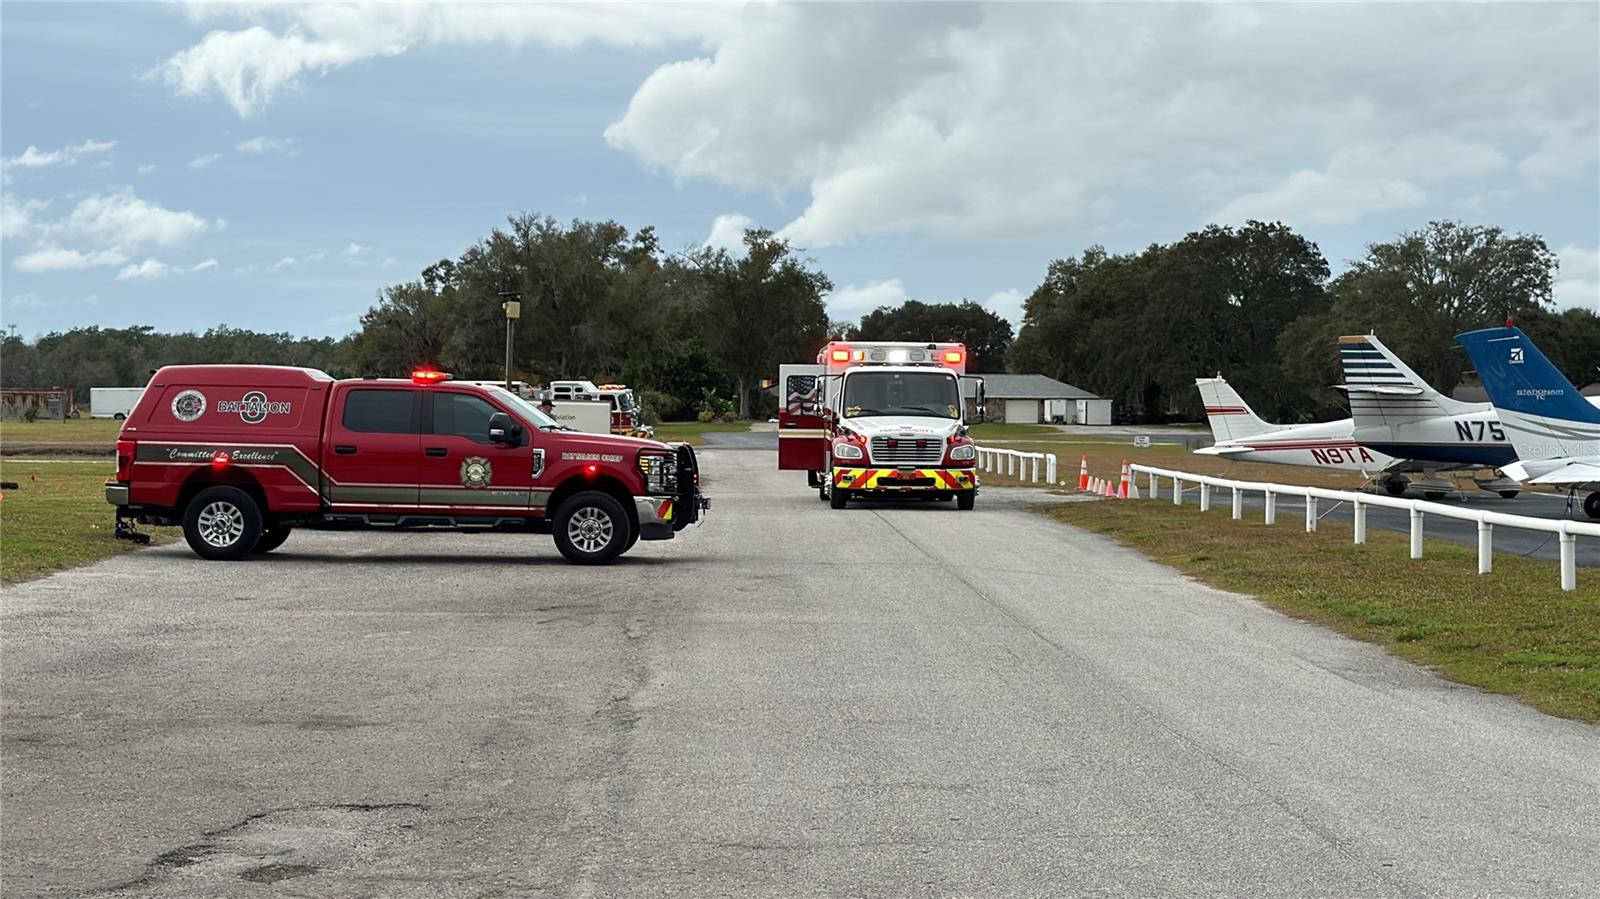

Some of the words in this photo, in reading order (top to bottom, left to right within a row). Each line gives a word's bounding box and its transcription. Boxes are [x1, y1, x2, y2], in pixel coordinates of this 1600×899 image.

[217, 401, 291, 414] BATTALION
[1454, 421, 1511, 442] N75
[1310, 447, 1375, 465] N9TA
